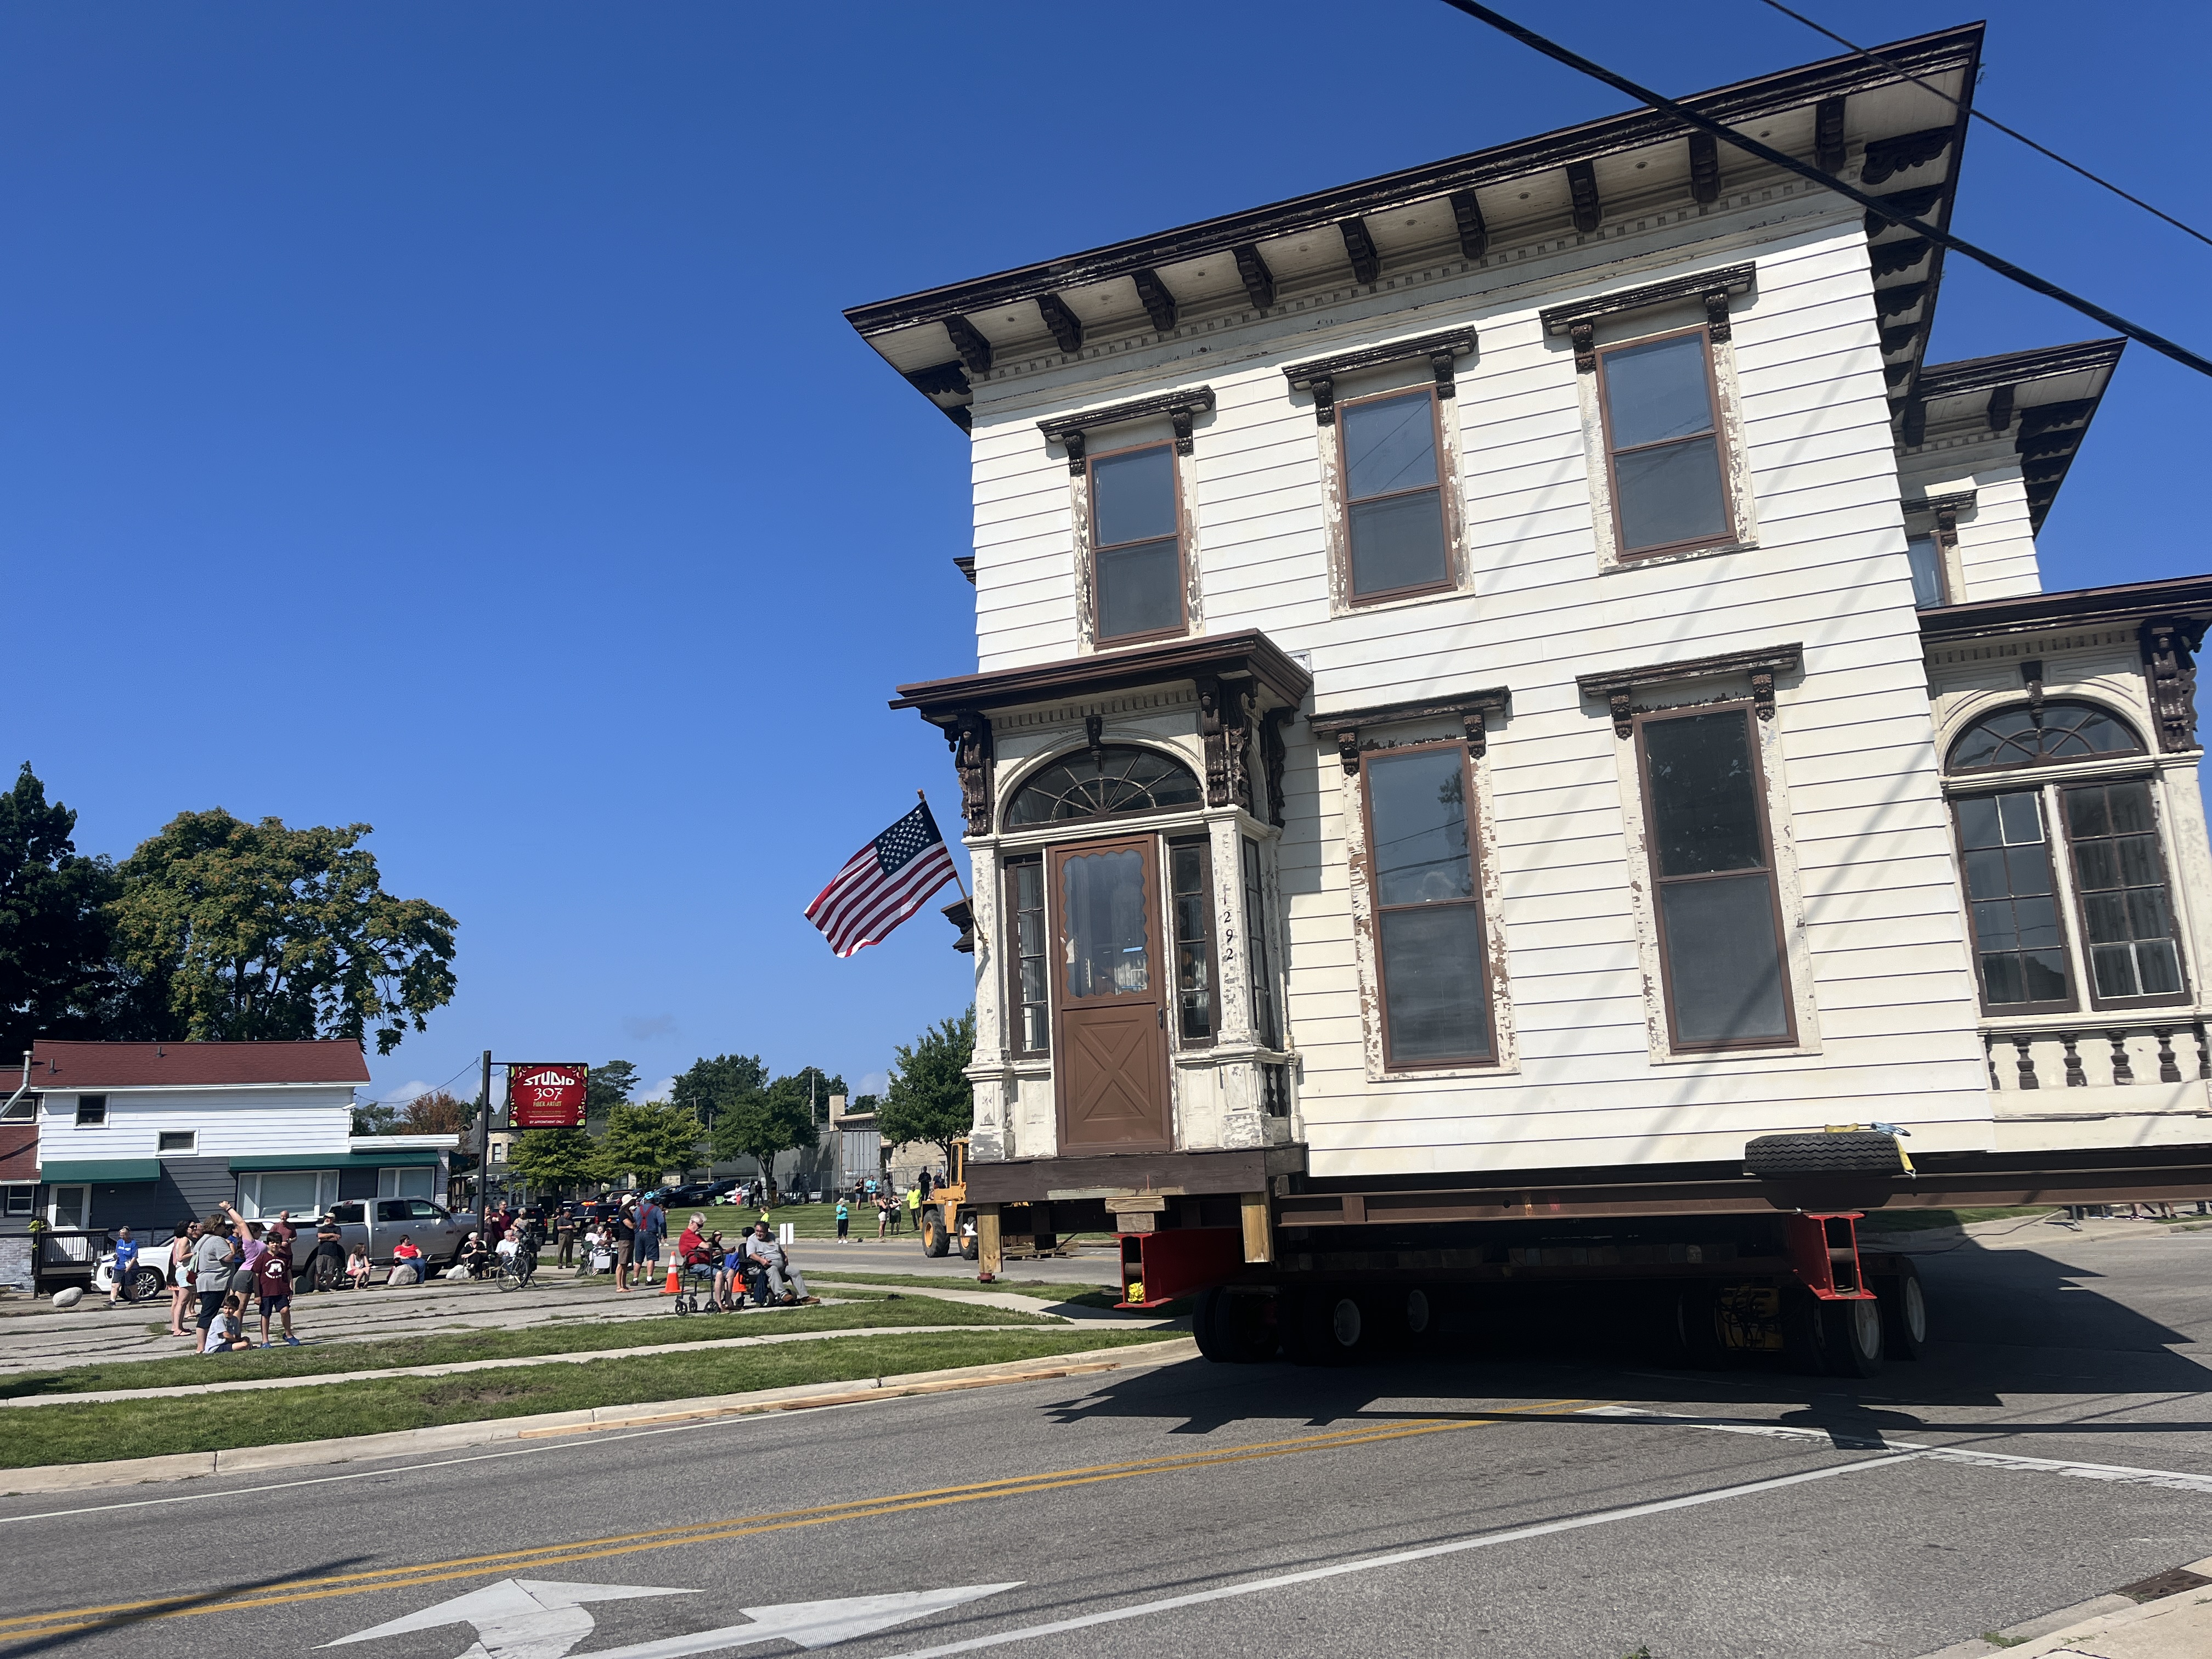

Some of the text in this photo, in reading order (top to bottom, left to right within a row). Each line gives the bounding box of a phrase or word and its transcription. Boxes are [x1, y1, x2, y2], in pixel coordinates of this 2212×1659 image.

[1223, 893, 1234, 961] 1292
[523, 1071, 575, 1086] STUDIO
[534, 1087, 563, 1101] 307
